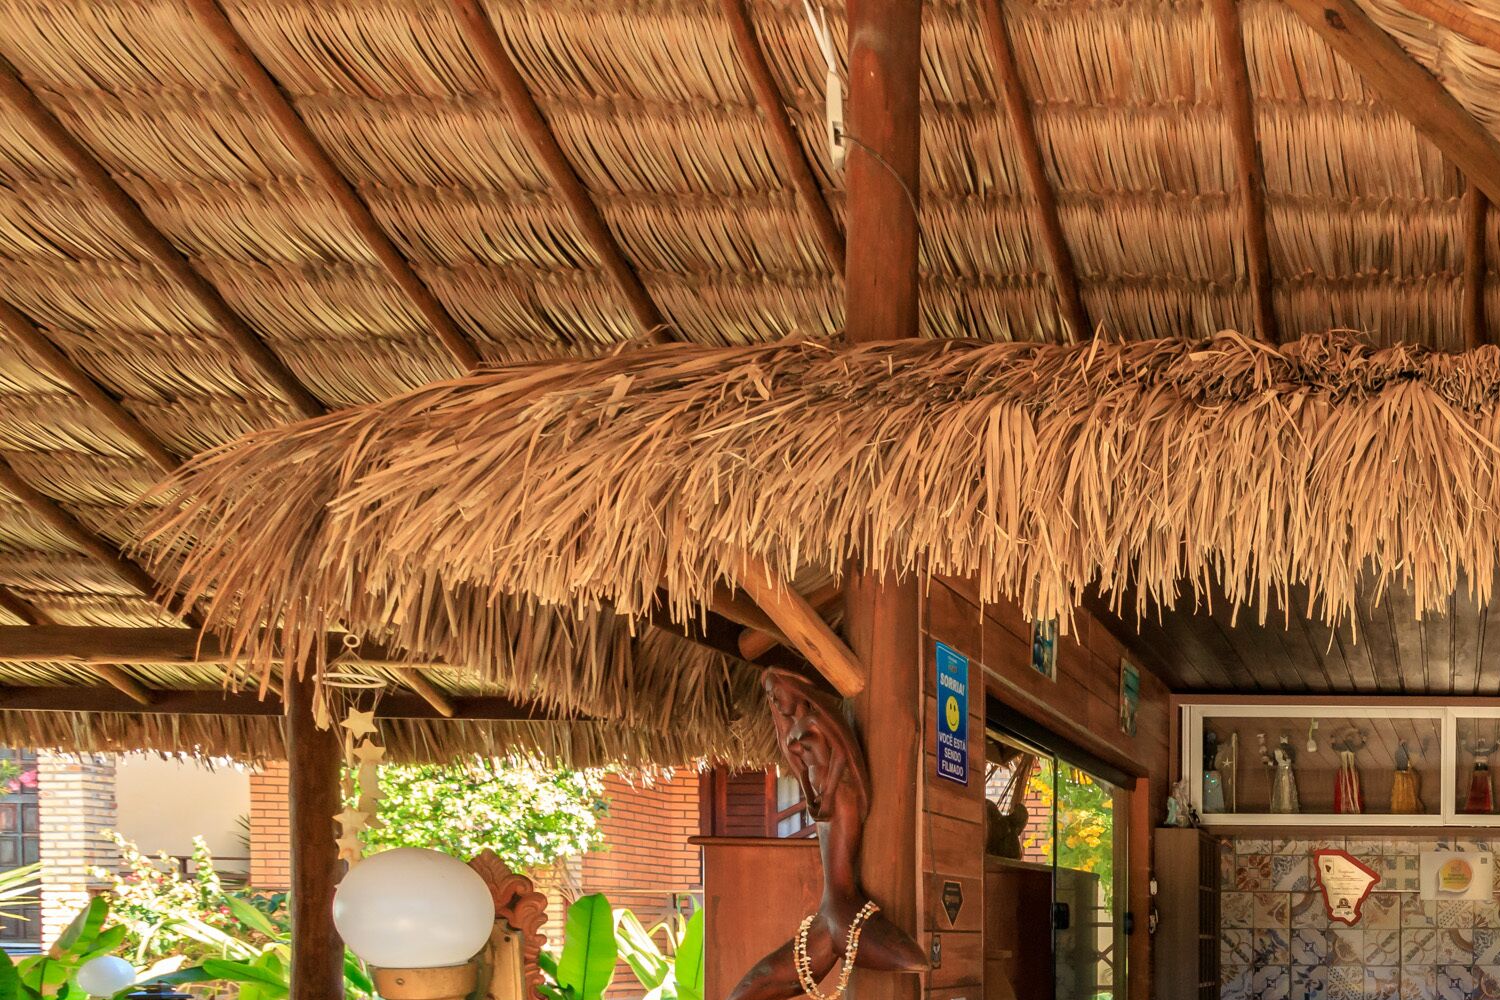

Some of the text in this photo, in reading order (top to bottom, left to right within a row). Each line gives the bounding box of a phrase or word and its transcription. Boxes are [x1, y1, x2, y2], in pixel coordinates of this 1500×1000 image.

[940, 673, 965, 696] SORRIA!
[944, 748, 962, 762] SENDO
[942, 760, 964, 776] FILMADO
